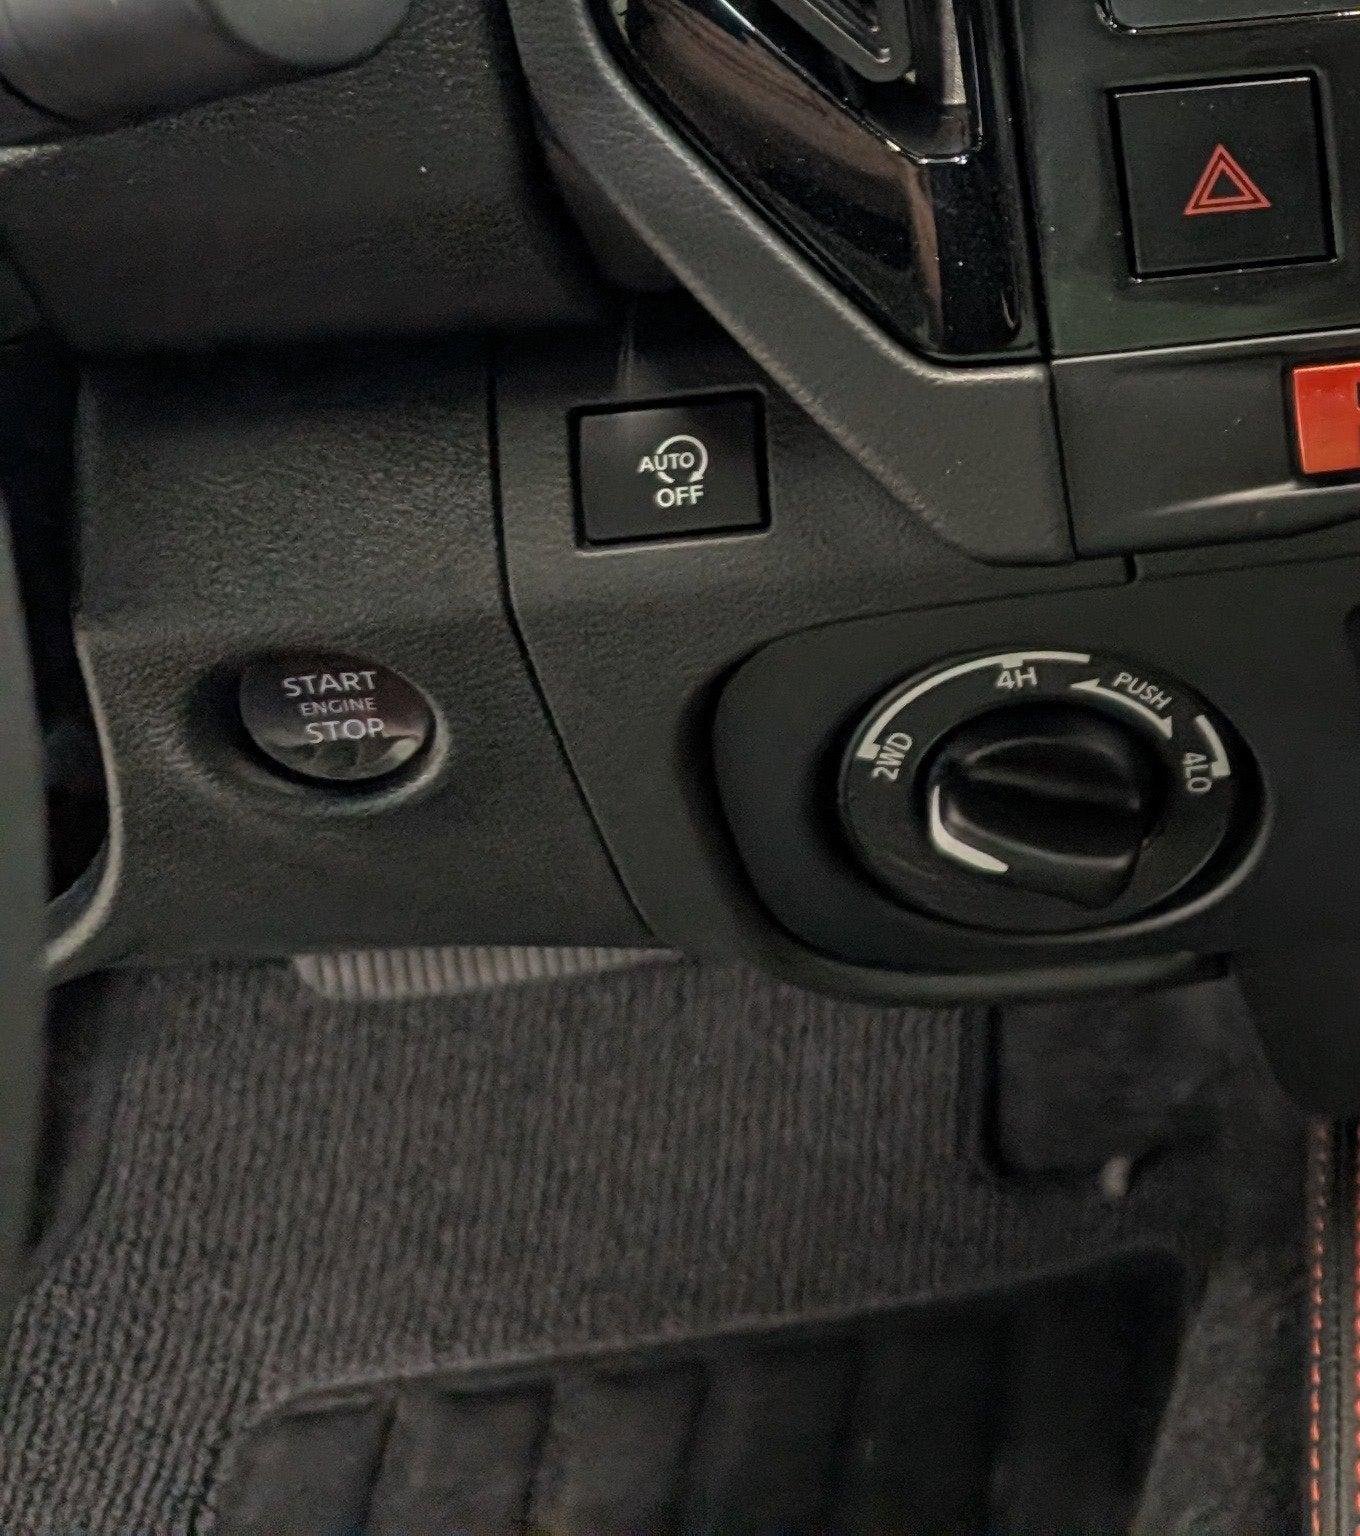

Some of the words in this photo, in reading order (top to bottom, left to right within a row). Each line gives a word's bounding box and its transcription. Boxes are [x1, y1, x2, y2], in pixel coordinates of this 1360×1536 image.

[637, 451, 696, 475] AUTO
[654, 484, 704, 508] OFF
[282, 670, 377, 698] START
[996, 666, 1038, 689] 4H
[1112, 671, 1173, 710] PUSH
[301, 696, 377, 718] ENGINE
[305, 717, 385, 745] STOP
[872, 731, 914, 782] 2WD
[1182, 750, 1214, 795] 4LO
